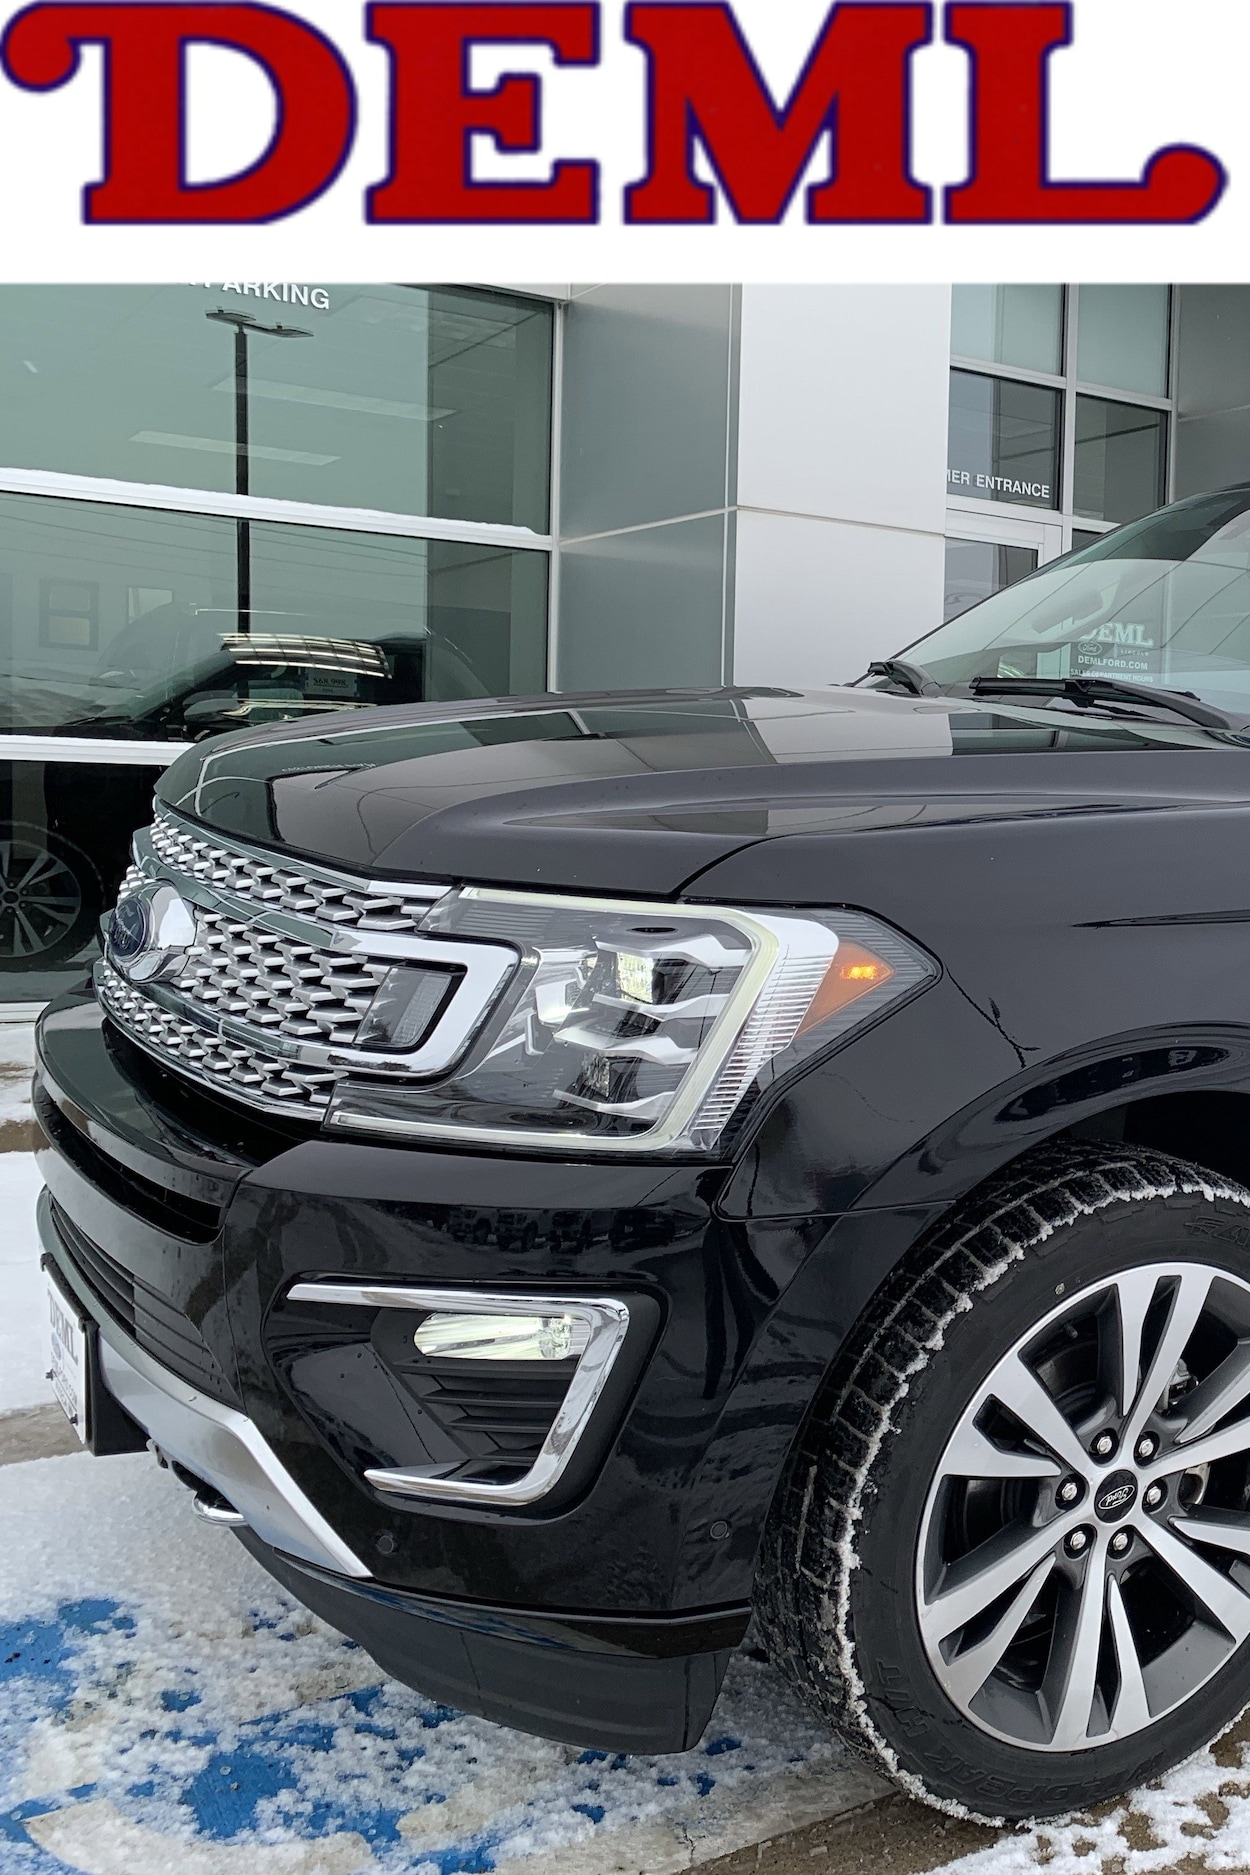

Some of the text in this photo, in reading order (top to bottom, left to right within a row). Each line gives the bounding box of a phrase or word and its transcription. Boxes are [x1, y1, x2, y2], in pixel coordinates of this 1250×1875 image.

[204, 281, 330, 309] ARKING
[947, 469, 1050, 498] ER ENTRANCE
[1078, 655, 1148, 670] DEMLFORD.COM
